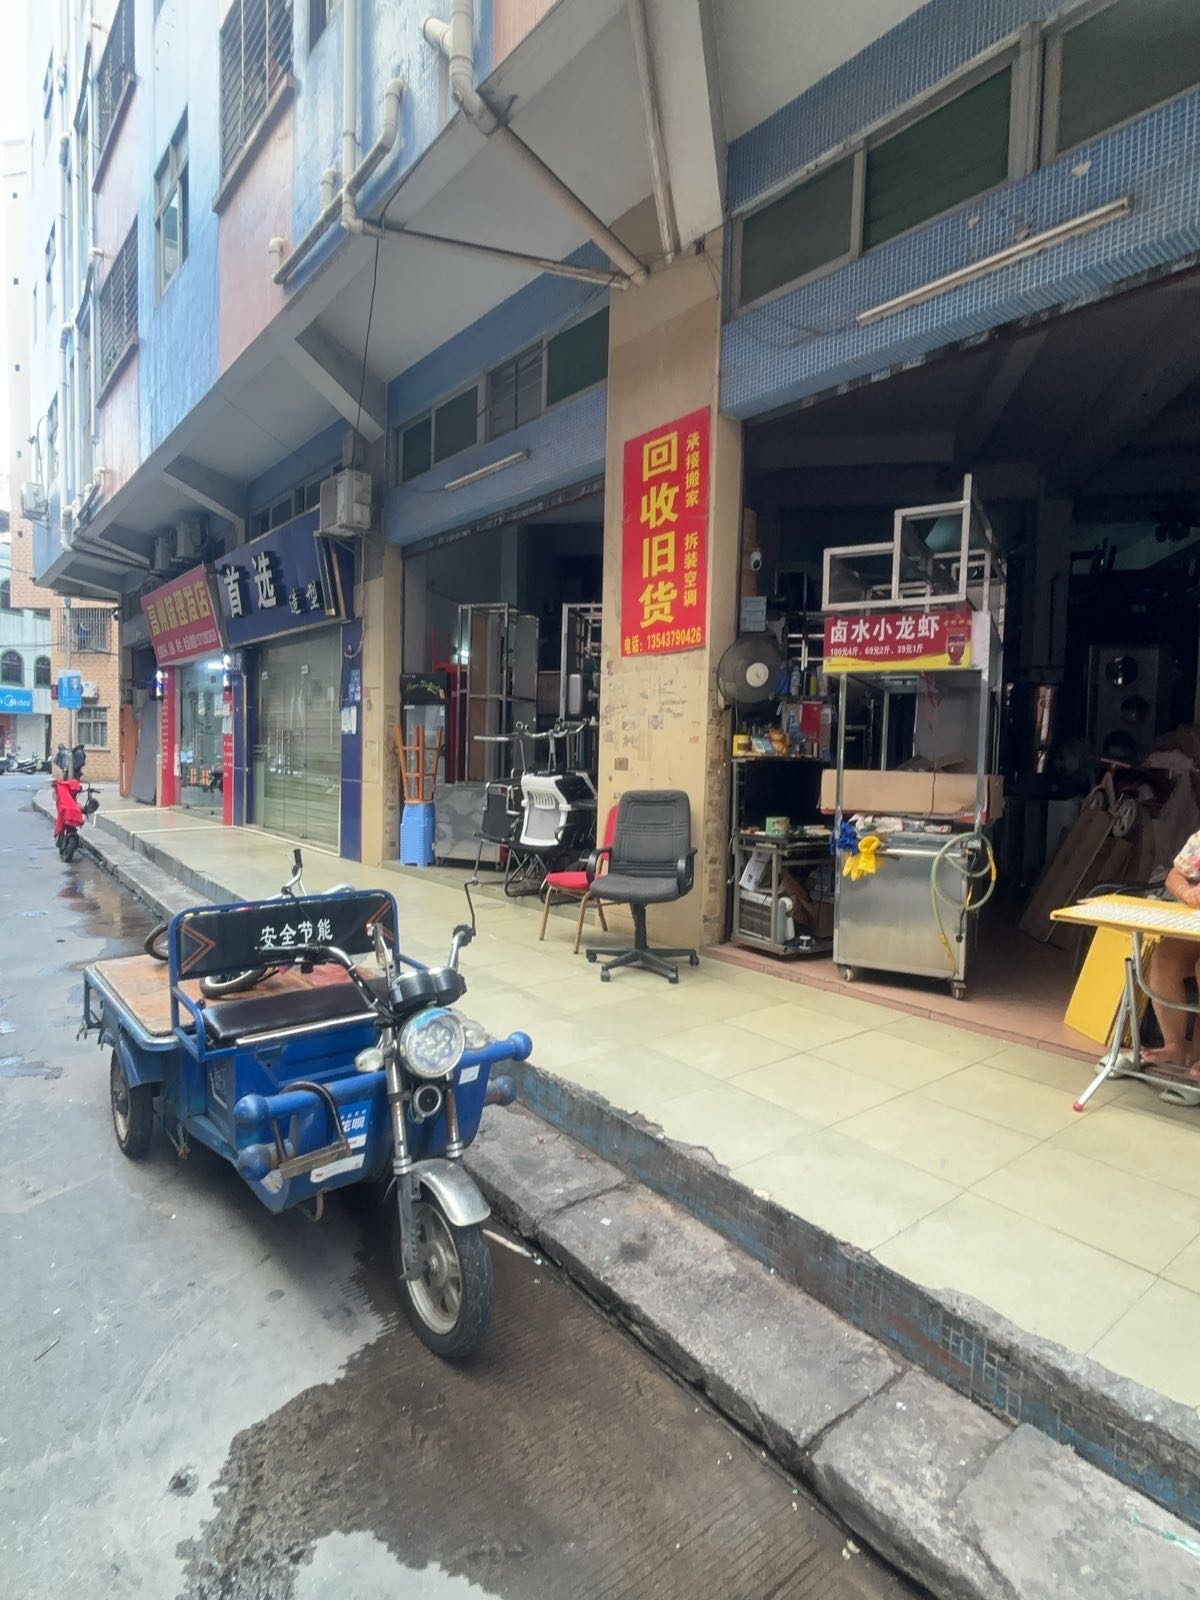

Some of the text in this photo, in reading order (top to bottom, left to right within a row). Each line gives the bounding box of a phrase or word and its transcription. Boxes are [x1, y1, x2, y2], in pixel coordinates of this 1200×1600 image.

[685, 430, 700, 508] 承接搬家
[639, 432, 680, 628] 回收旧货
[224, 552, 320, 618] 首选 造型
[684, 532, 698, 607] 拆装空调
[831, 614, 940, 643] 卤水小龙虾
[261, 919, 333, 948] 安全节能
